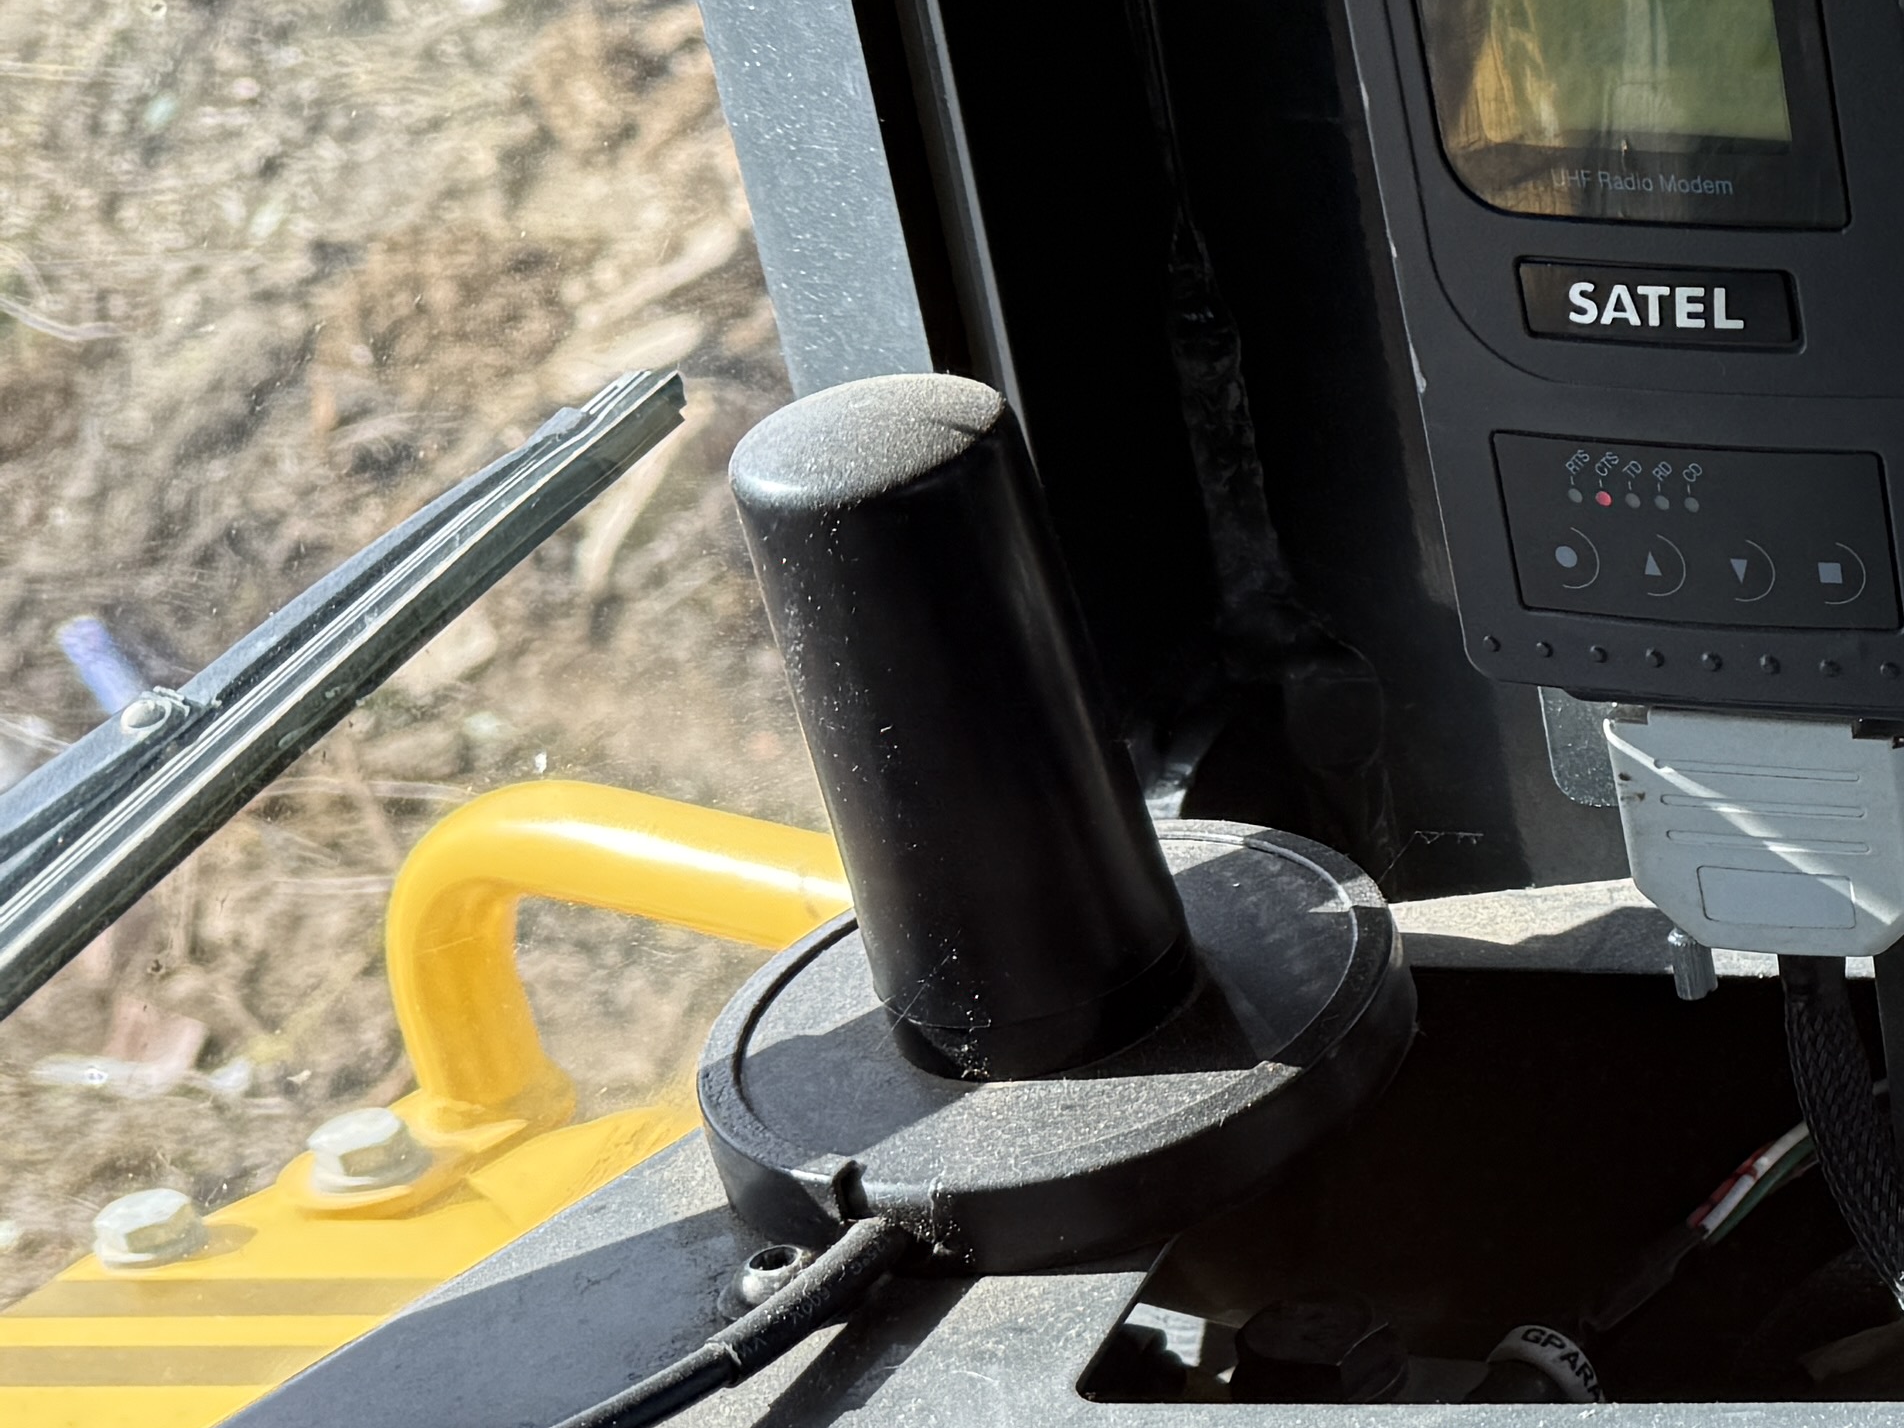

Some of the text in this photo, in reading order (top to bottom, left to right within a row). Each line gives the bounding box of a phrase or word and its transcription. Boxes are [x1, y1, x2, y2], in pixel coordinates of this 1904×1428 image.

[1551, 168, 1733, 196] UHF Radio Modem
[1567, 281, 1745, 330] SATEL
[1565, 449, 1591, 477] RTS
[1594, 450, 1620, 478] CTS
[1622, 459, 1643, 479] TD
[1653, 460, 1674, 482] RD
[1682, 462, 1703, 484] CD
